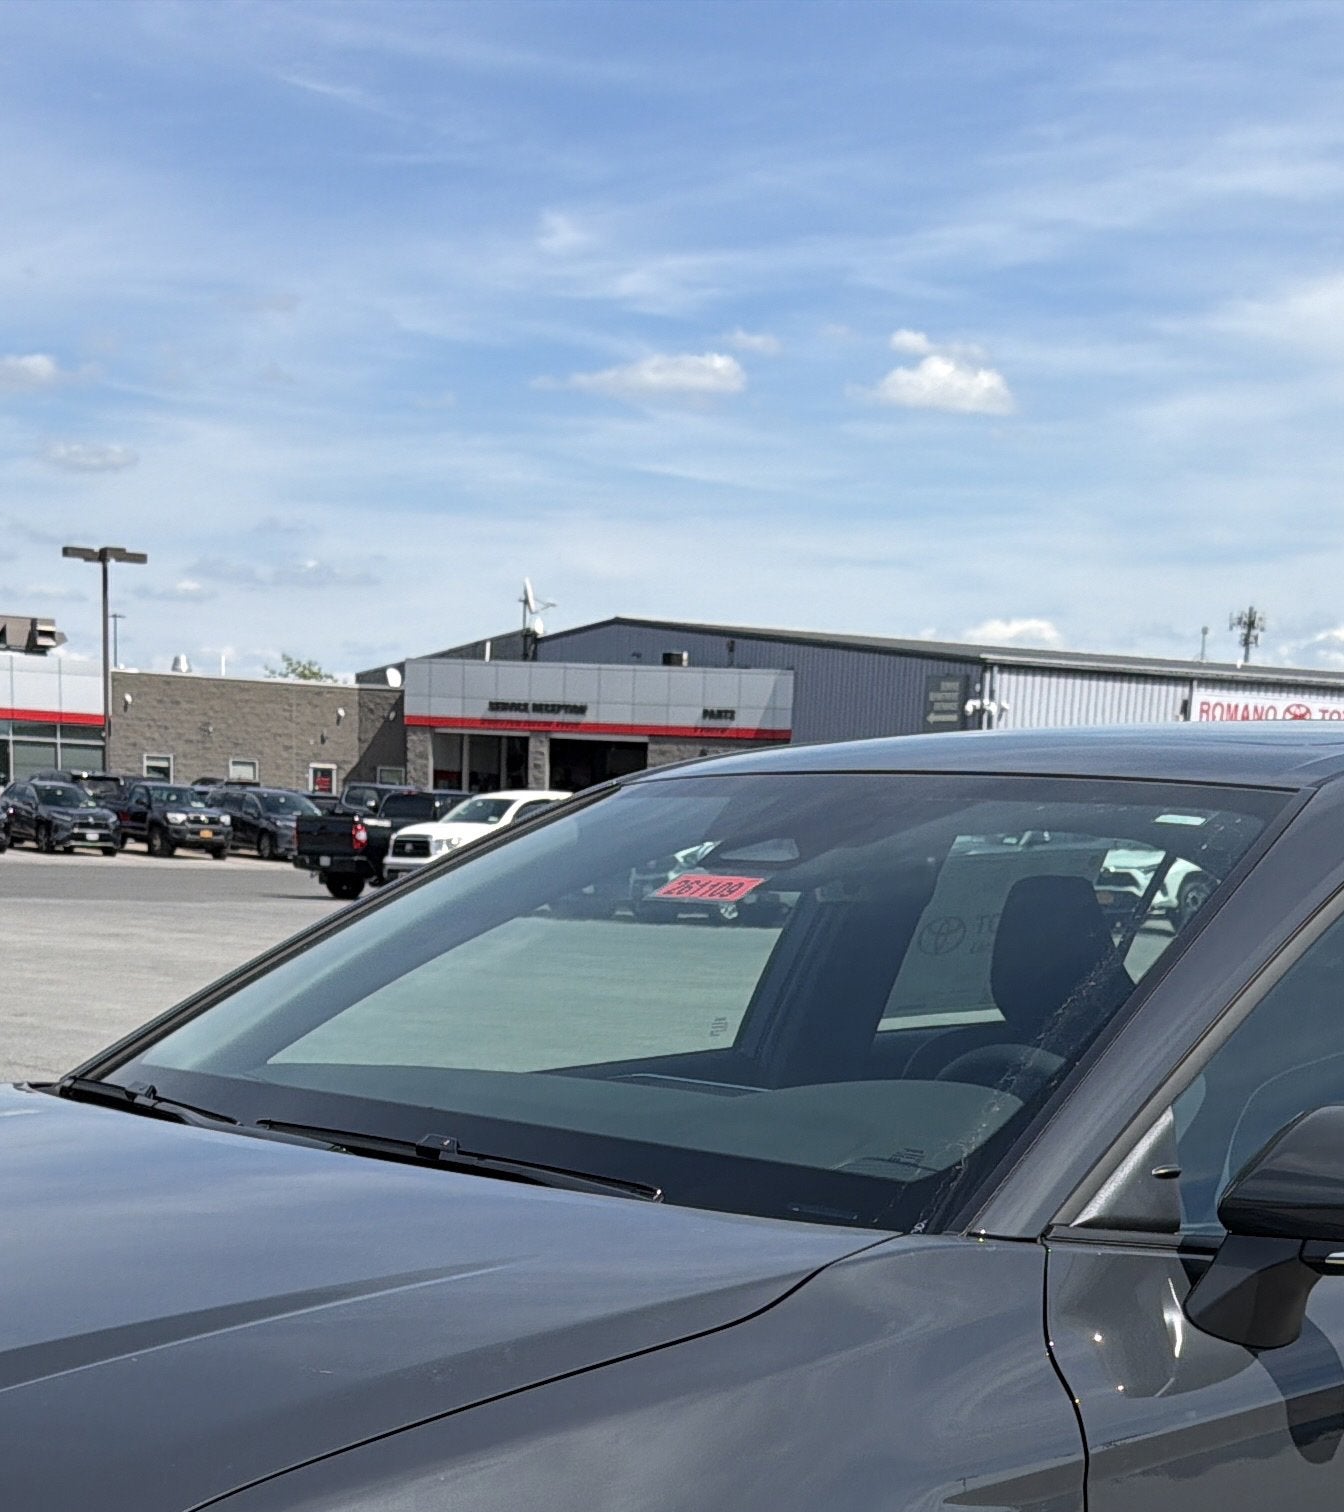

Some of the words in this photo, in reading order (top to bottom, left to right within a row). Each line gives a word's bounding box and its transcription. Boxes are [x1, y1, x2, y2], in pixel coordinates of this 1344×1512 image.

[702, 709, 736, 721] PARTS
[1199, 701, 1278, 720] ROMANO
[662, 880, 745, 897] 261109
